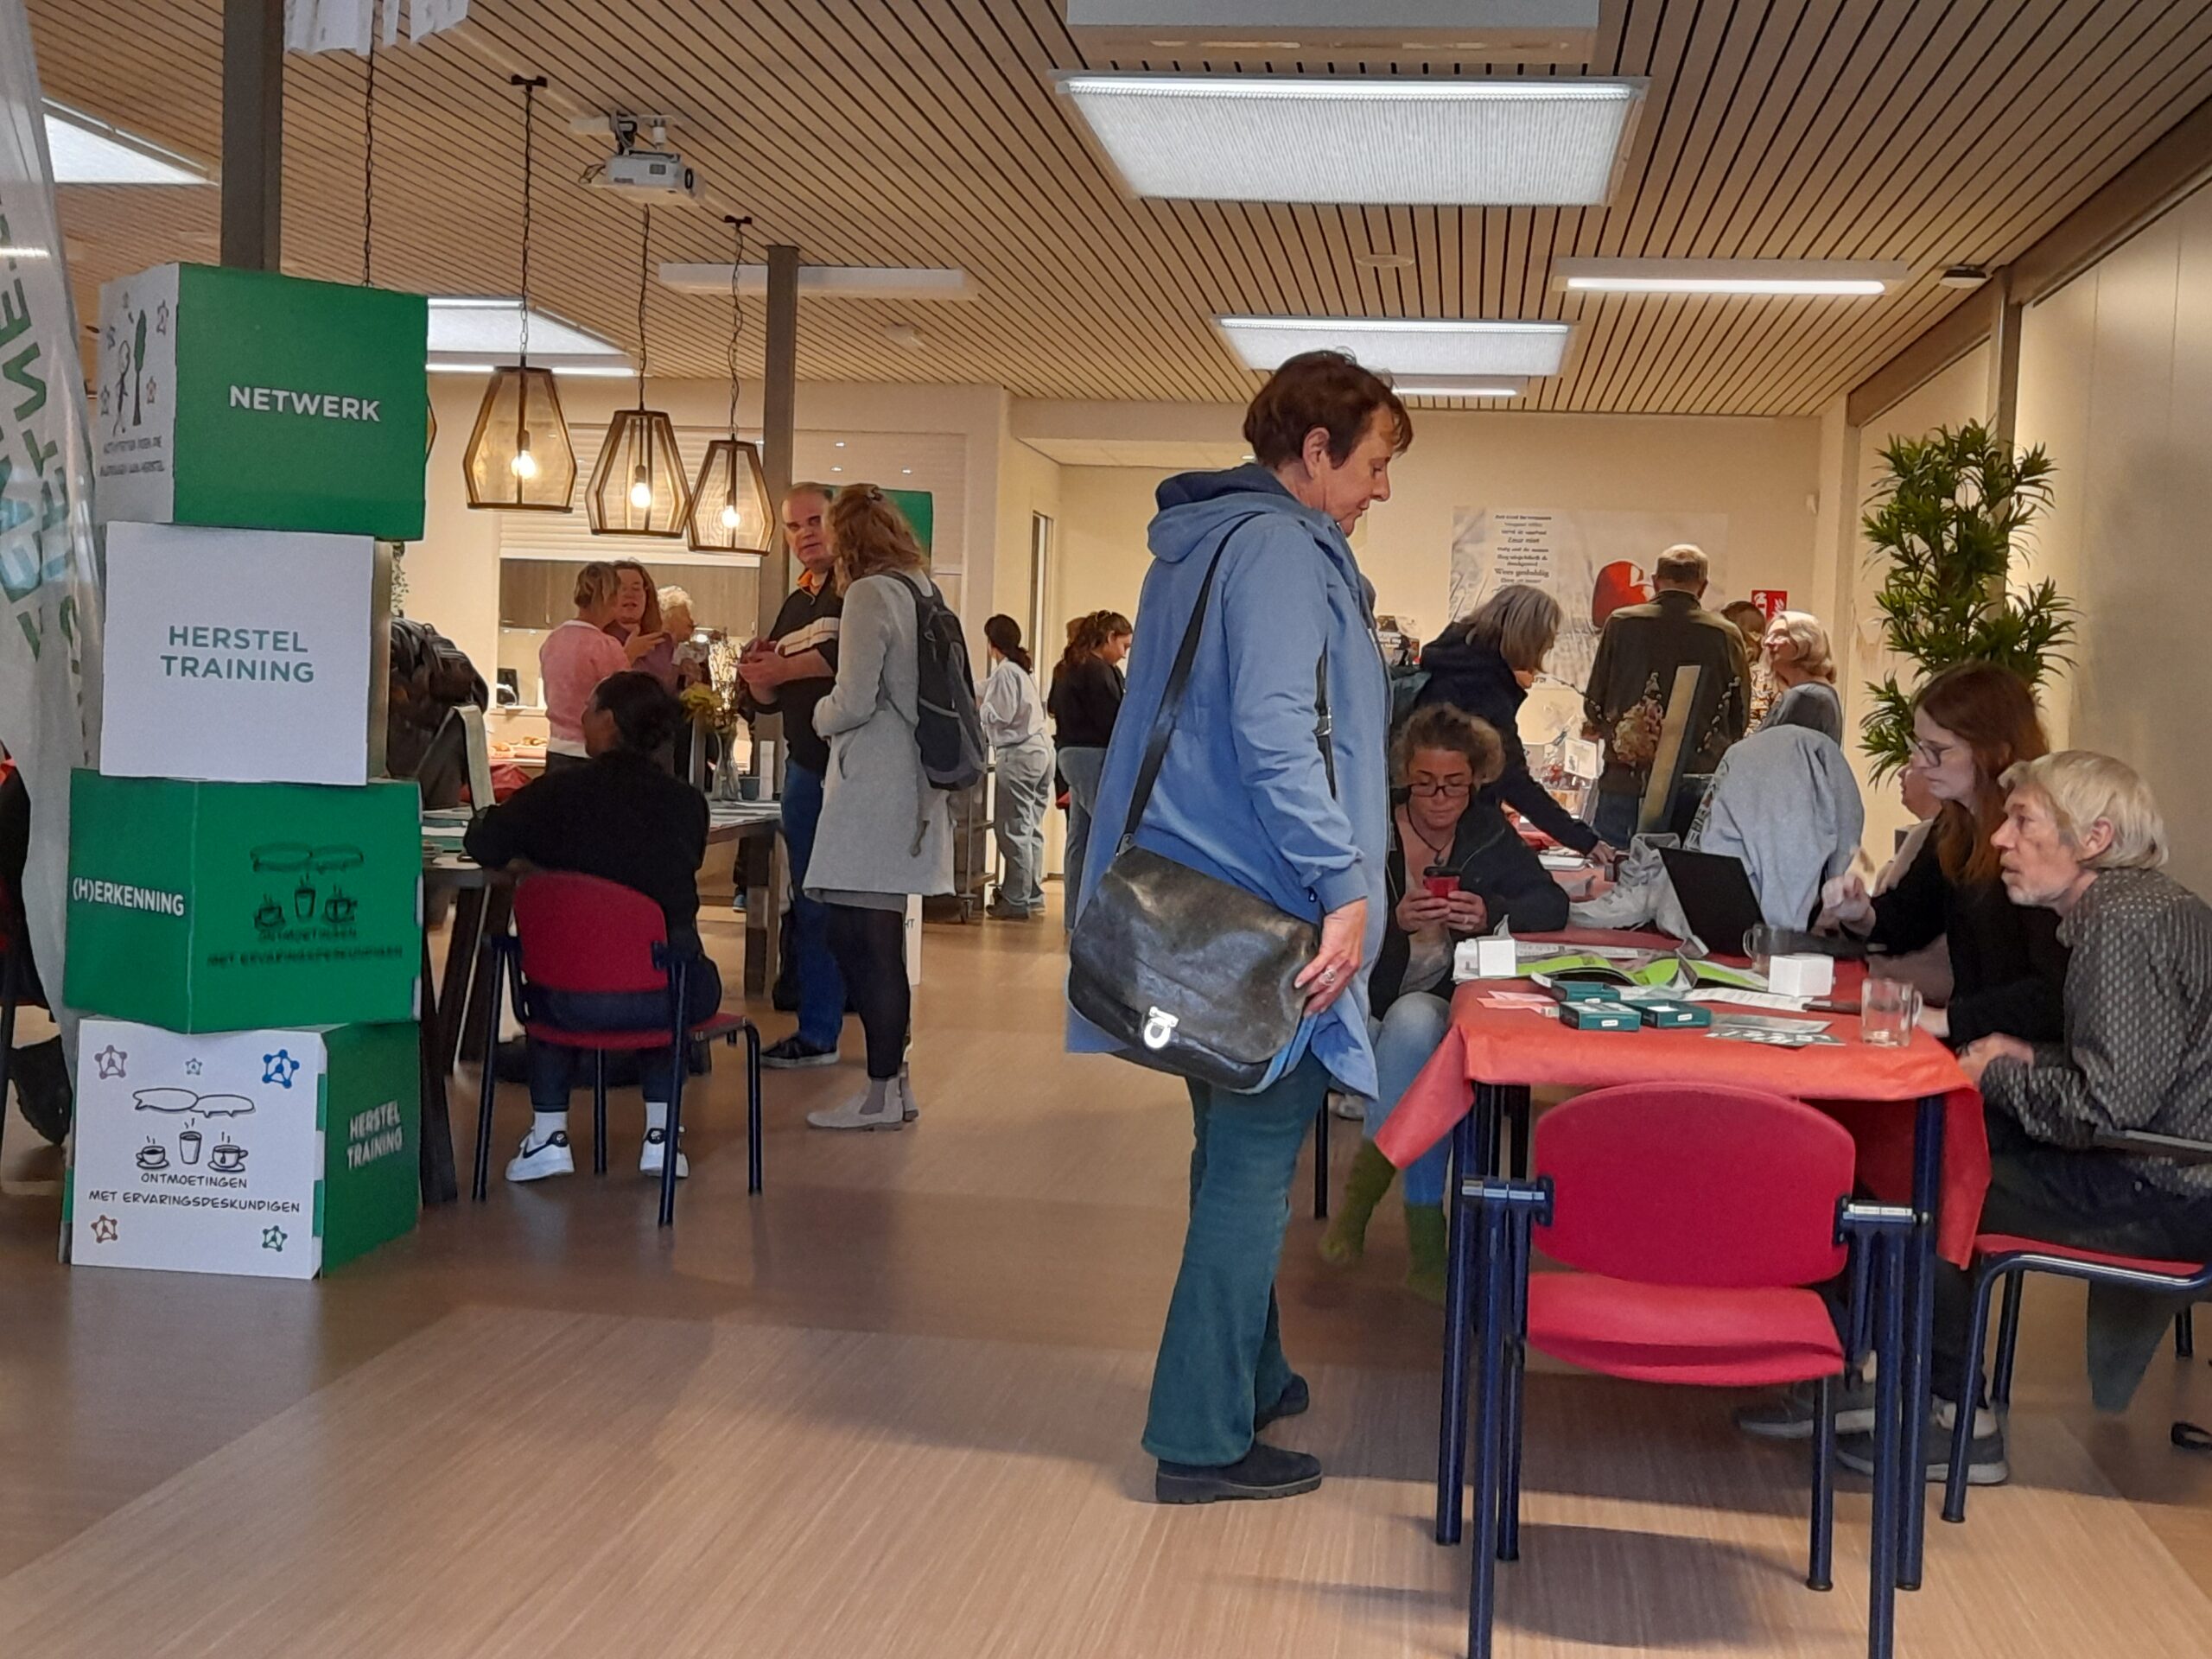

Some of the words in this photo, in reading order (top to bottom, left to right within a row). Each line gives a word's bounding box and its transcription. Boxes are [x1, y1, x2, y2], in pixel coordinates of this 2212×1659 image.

[230, 385, 380, 422] NETWERK
[168, 625, 308, 653] HERSTEL
[160, 655, 315, 683] TRAINING
[73, 877, 184, 916] (H)ERKENNING
[349, 1099, 401, 1141] HERSTEL
[346, 1125, 403, 1171] TRAINING
[140, 1173, 248, 1189] ONTMOETINGEN
[88, 1190, 118, 1202] MET
[123, 1192, 301, 1213] ERVARINGSDESKUNDIGEN
